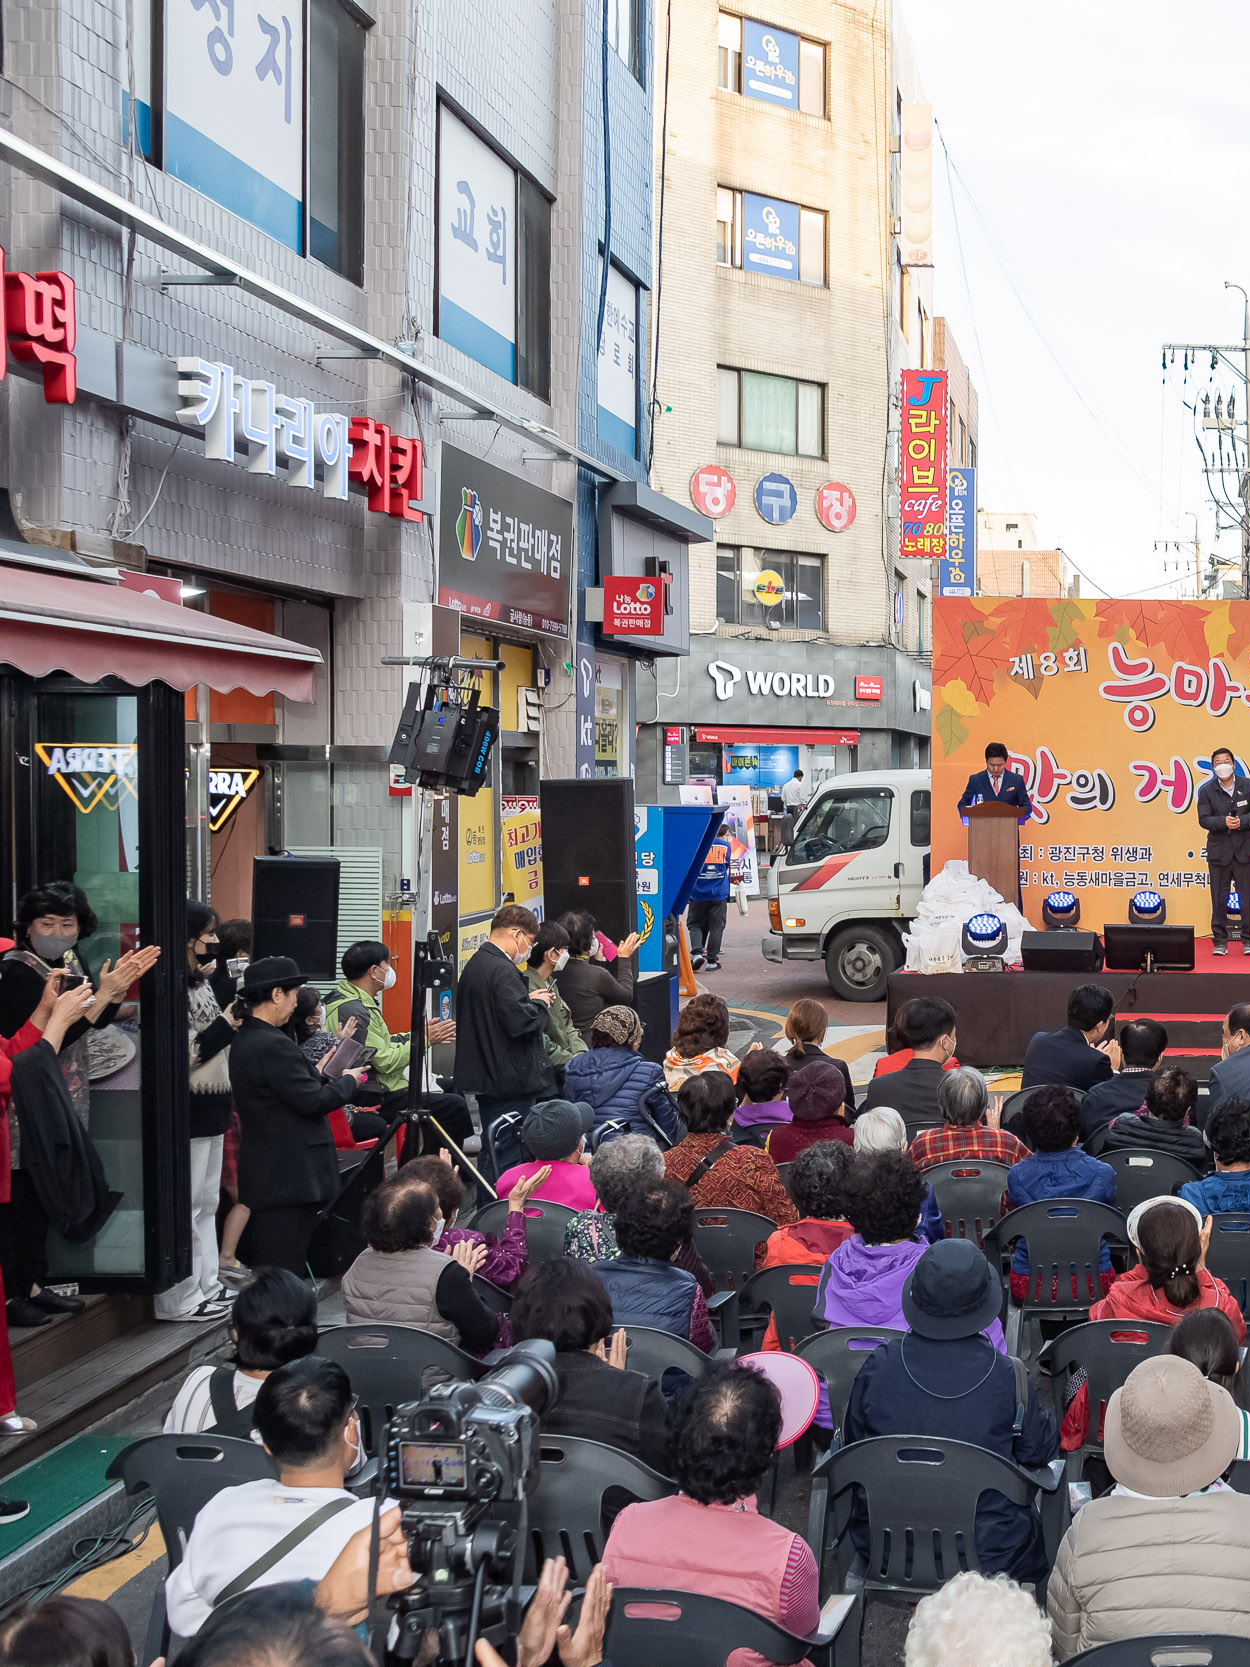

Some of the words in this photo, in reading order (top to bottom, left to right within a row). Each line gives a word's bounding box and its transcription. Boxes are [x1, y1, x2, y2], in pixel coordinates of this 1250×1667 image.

[450, 180, 507, 286] 교회
[908, 376, 941, 406] J
[177, 357, 354, 501] 카나리아
[349, 416, 423, 523] 치킨
[908, 409, 940, 493] 라이브
[698, 472, 853, 530] 당구장
[903, 495, 943, 519] cafe
[486, 507, 562, 580] 복권판매점
[903, 537, 945, 554] 노래장
[613, 602, 651, 615] Lotto
[613, 618, 651, 629] 복권판매점
[747, 670, 836, 699] WORLD
[480, 730, 492, 757] 400W
[581, 714, 593, 746] kt
[1048, 845, 1105, 862] 광진구청
[1110, 846, 1153, 863] 위생과
[1042, 871, 1059, 887] kt,
[1063, 871, 1153, 889] 능동새마을금고,
